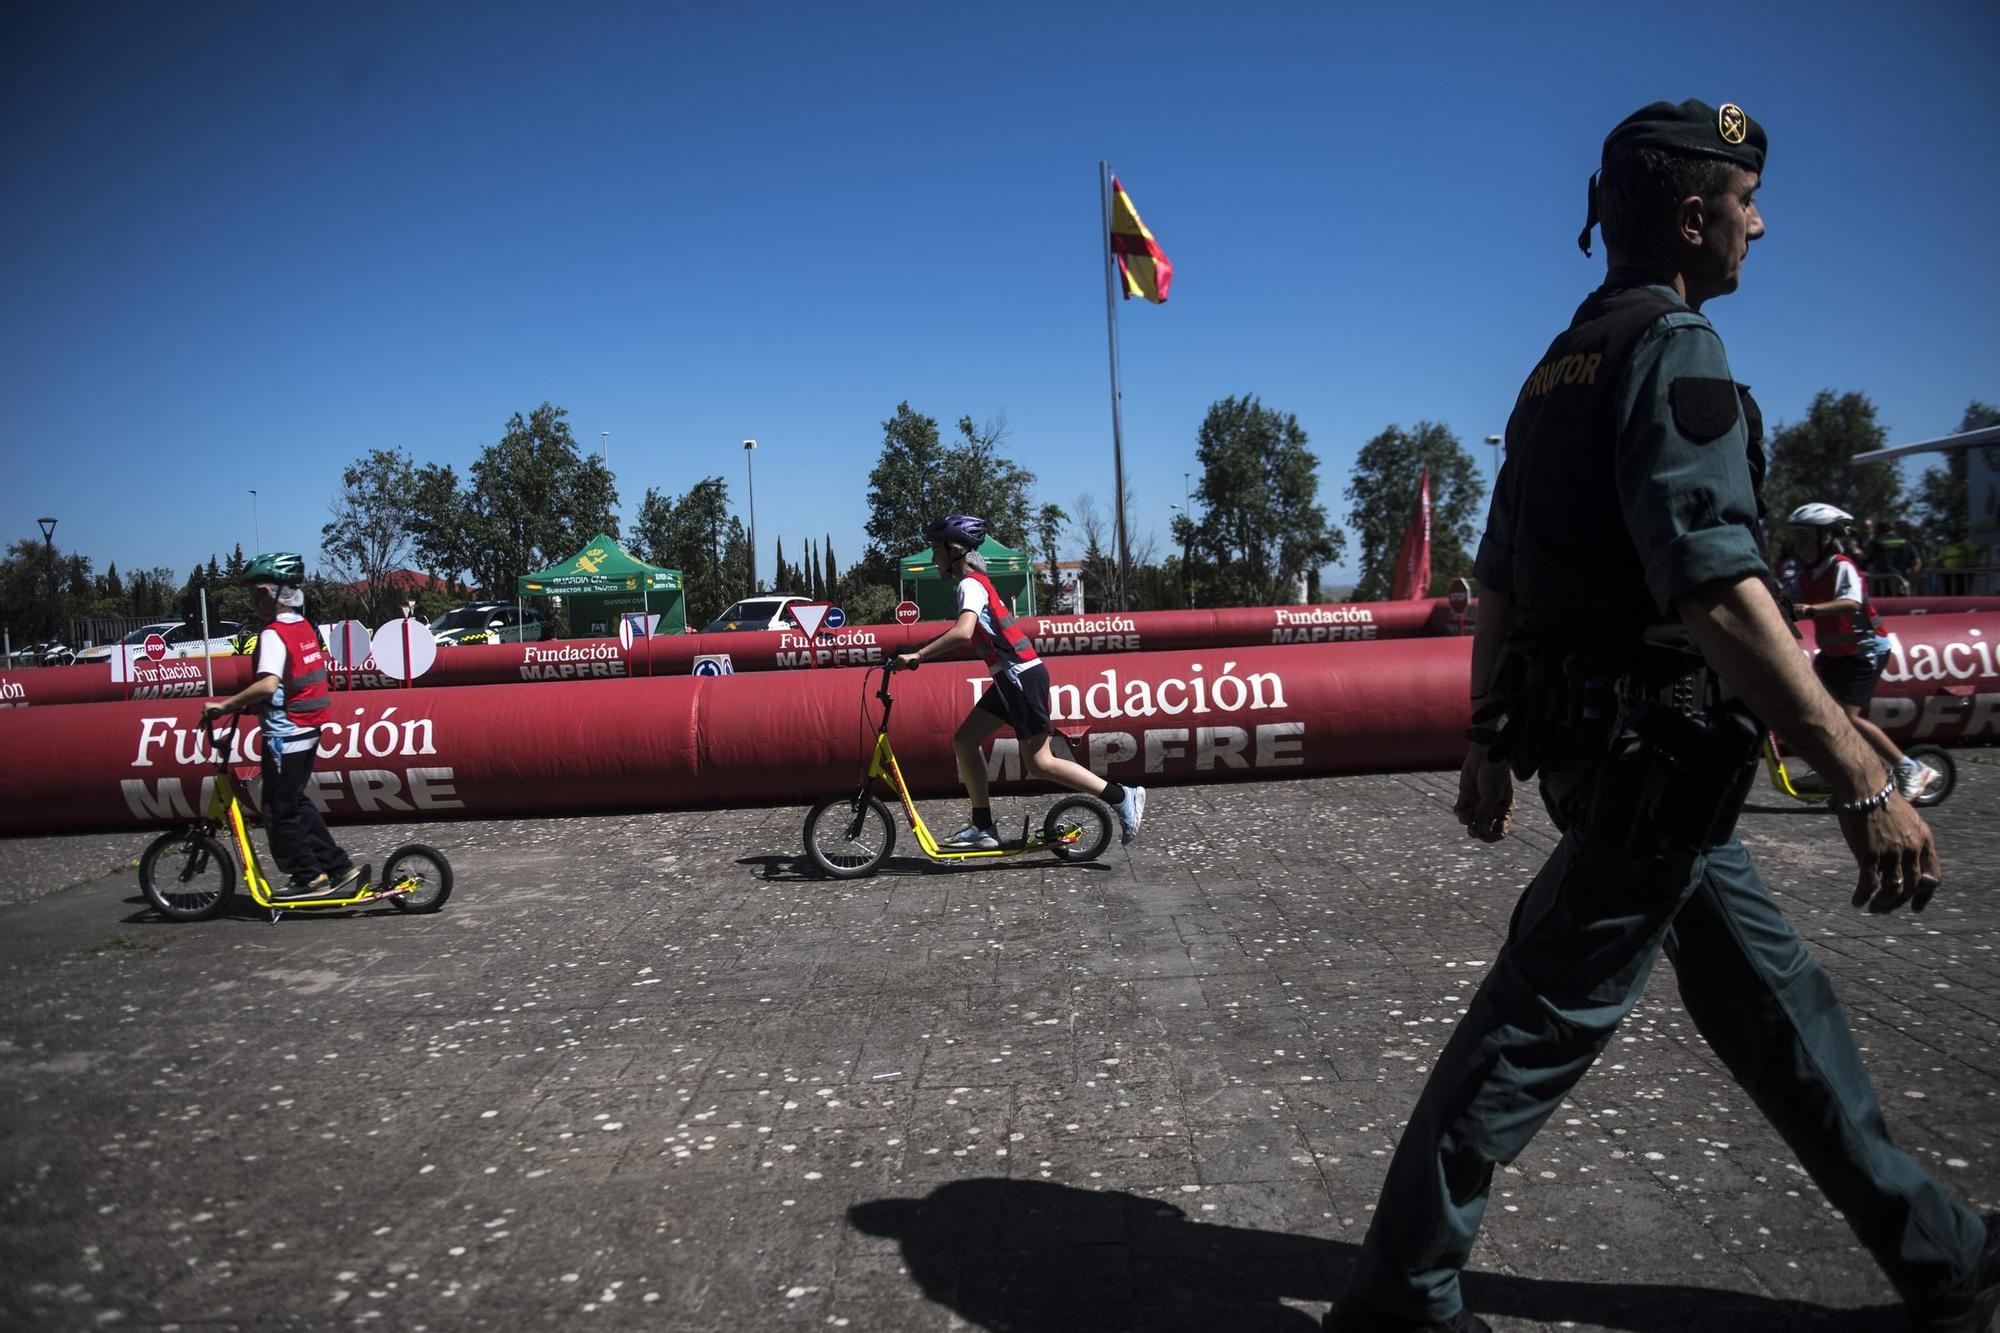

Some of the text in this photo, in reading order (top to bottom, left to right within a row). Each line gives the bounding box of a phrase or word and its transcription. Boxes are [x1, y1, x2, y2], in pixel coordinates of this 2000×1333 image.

[898, 609, 917, 618] STOP
[1275, 605, 1373, 626] Fundación
[1038, 617, 1135, 637] Fundación
[1272, 624, 1379, 645] MAPFRE
[147, 644, 164, 652] STOP
[779, 630, 876, 649] Fundación
[1034, 634, 1140, 654] MAPFRE
[523, 643, 619, 664] Fundación
[776, 647, 882, 667] MAPFRE
[134, 662, 202, 683] Fundación
[519, 660, 627, 681] MAPFRE
[130, 680, 206, 700] MAPFRE
[966, 661, 1288, 722] ndación
[131, 706, 437, 767] Función
[120, 766, 465, 819] MFRE
